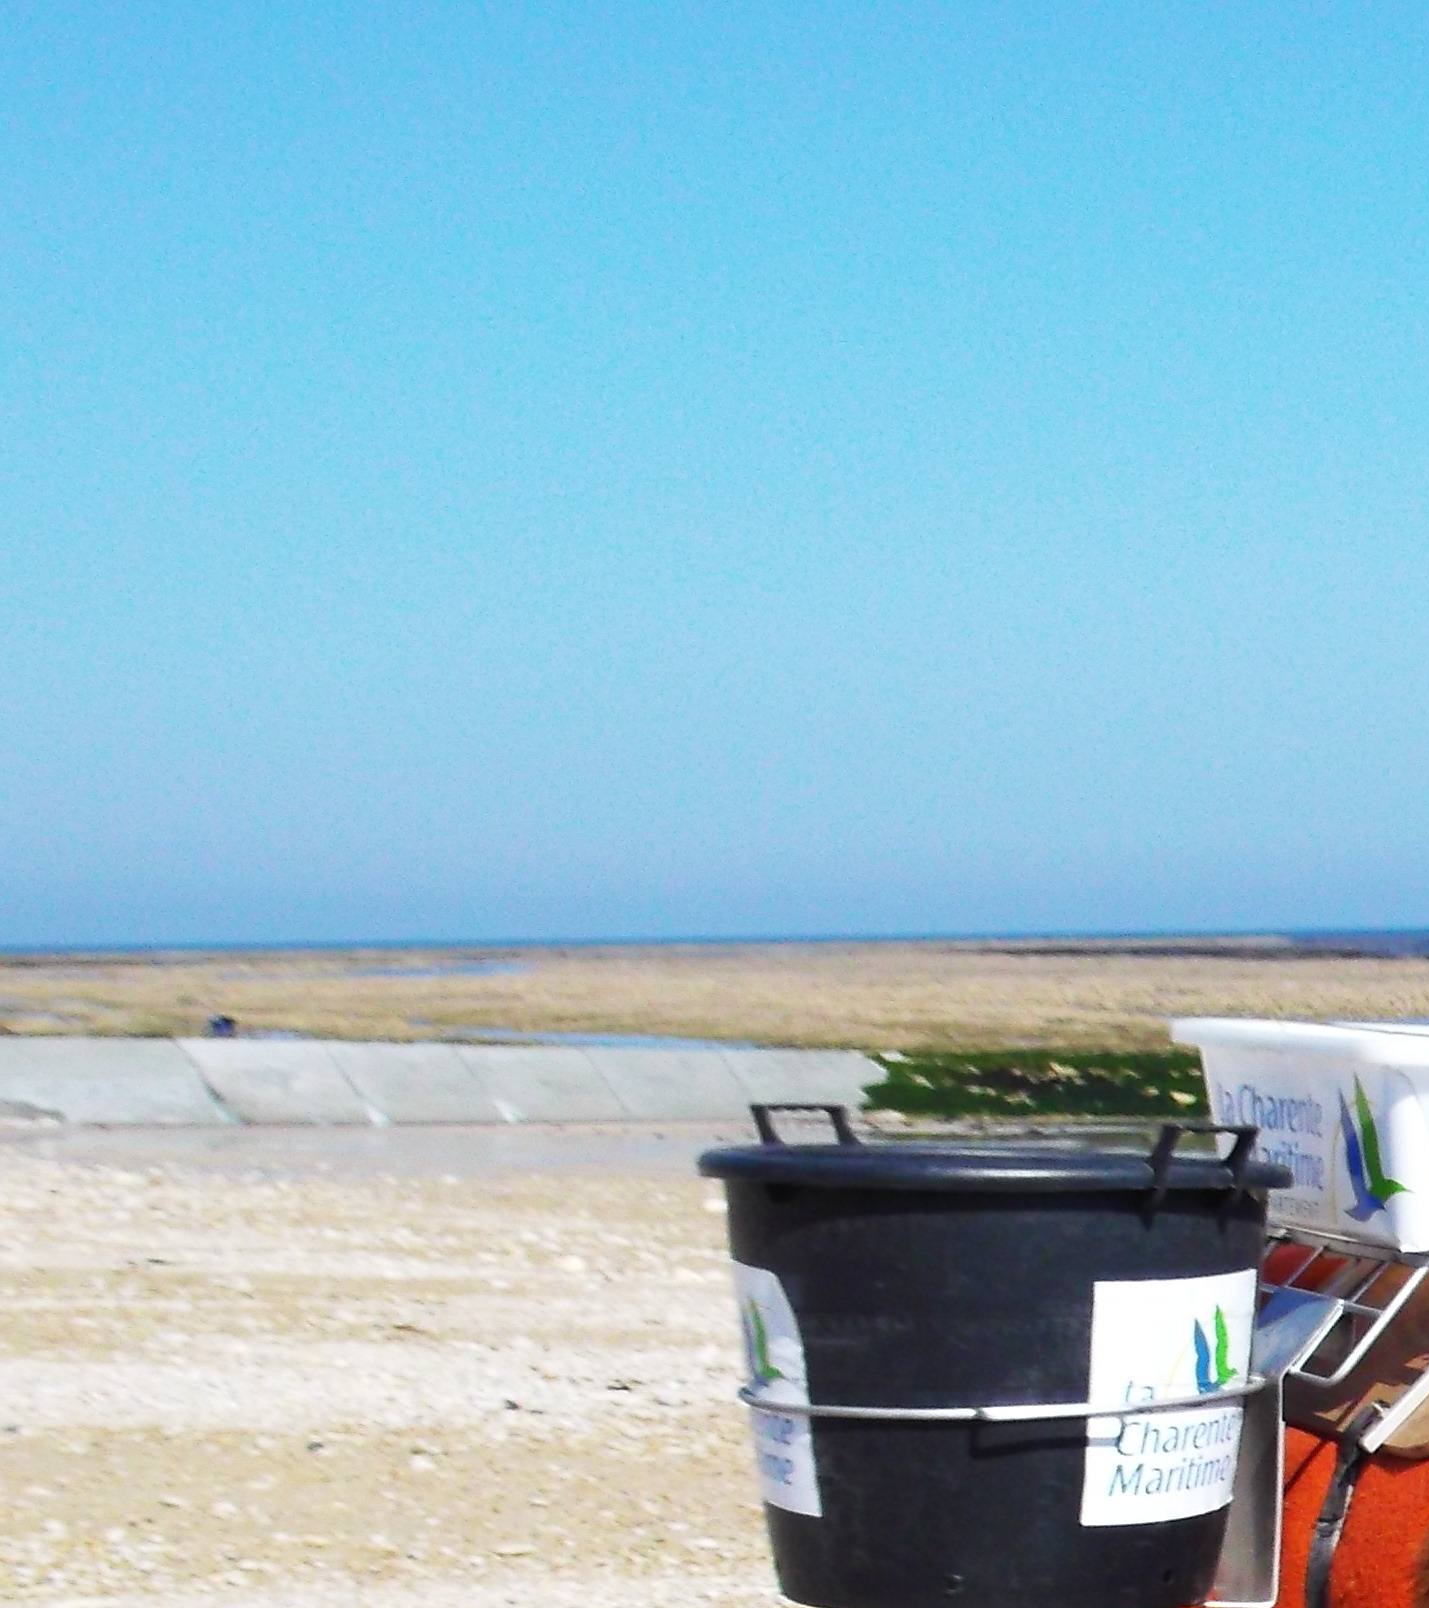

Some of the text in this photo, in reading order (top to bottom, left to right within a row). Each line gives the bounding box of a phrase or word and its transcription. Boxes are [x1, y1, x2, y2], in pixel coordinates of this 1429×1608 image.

[1237, 1084, 1323, 1139] Charente
[1117, 1412, 1238, 1457] Charente
[1108, 1455, 1230, 1497] Maritime
